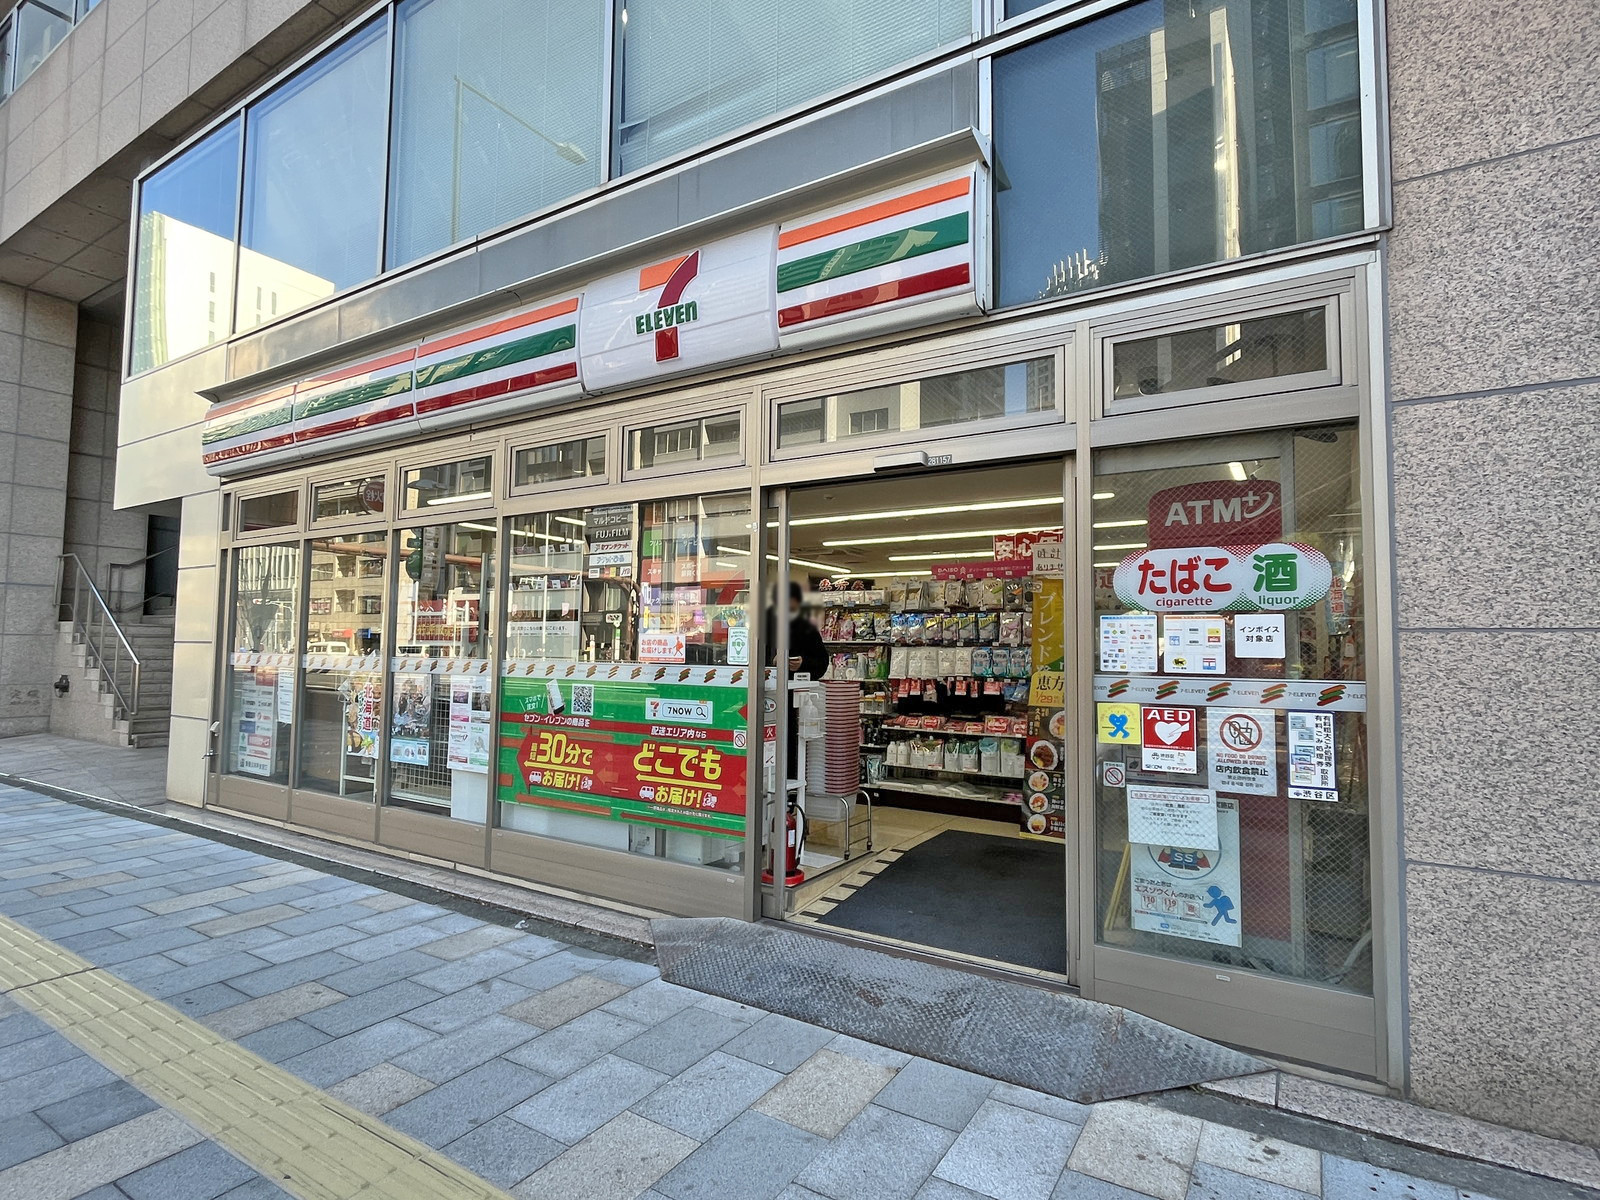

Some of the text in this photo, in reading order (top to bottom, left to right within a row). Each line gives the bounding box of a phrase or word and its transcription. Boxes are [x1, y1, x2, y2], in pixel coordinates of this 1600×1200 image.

[928, 456, 951, 466] 281157
[1138, 553, 1298, 595] たばこ 酒
[1156, 597, 1213, 608] cigarette
[1258, 595, 1300, 606] liquor
[1239, 625, 1280, 634] インボイス
[1245, 634, 1274, 643] 対象店
[667, 707, 692, 715] 7NOW
[1147, 710, 1191, 722] AED
[650, 726, 707, 739] 配送エリア内なら
[633, 743, 722, 780] どこでも
[1215, 765, 1269, 776] 店内飲食禁止
[1303, 790, 1336, 800] 渋谷区
[1142, 895, 1177, 907] 110 119
